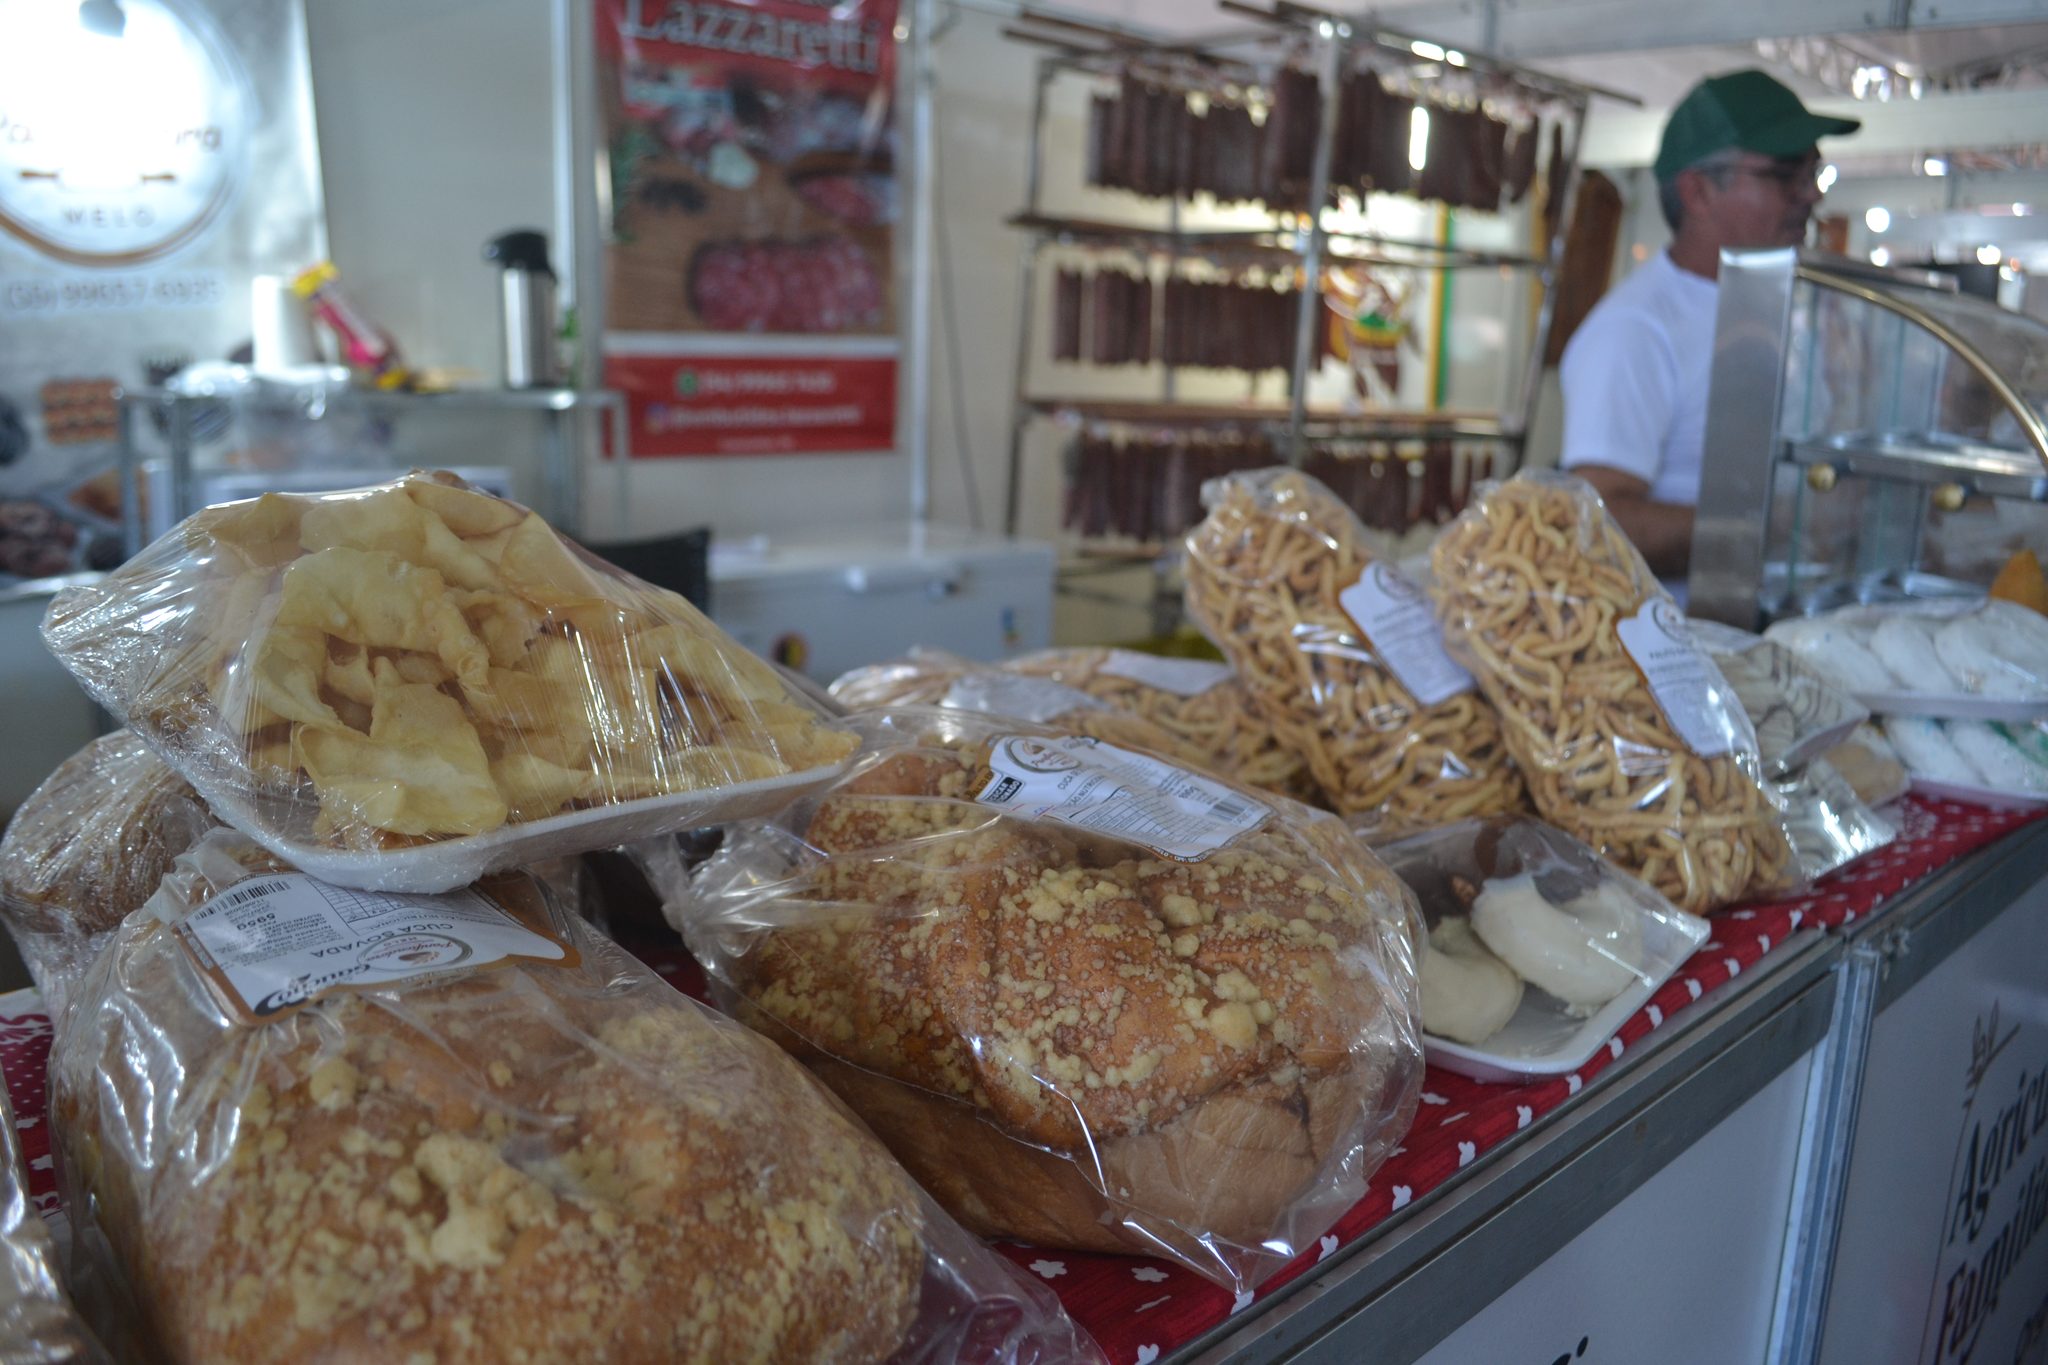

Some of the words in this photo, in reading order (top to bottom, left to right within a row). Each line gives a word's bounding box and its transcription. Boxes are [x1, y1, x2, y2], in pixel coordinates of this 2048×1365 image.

[620, 0, 880, 74] Lazzaretti
[236, 912, 276, 931] 595g
[398, 923, 454, 934] CUCA
[310, 929, 395, 958] SOVADA
